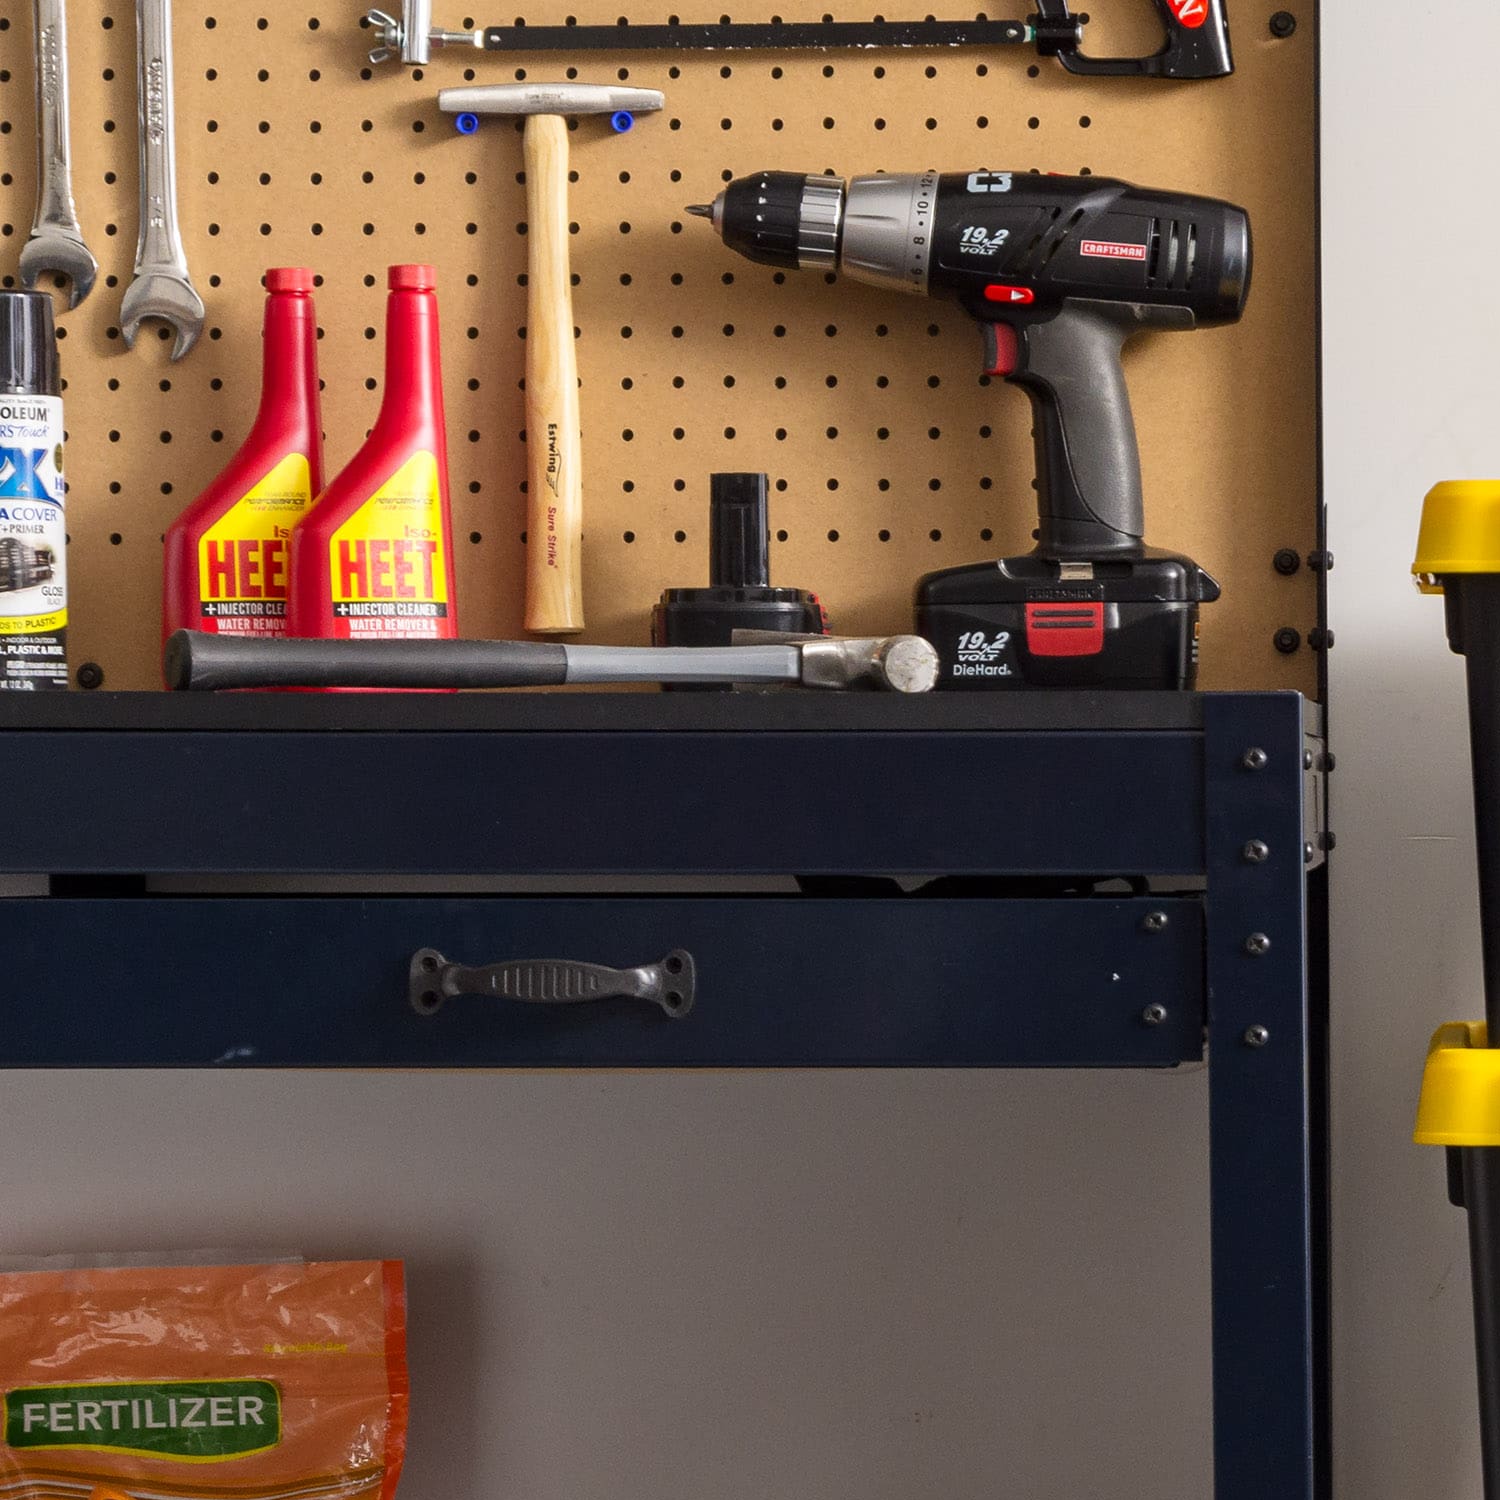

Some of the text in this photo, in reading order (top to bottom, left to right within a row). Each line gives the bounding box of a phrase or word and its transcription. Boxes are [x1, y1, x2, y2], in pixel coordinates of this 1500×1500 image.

[966, 172, 1013, 192] C3
[917, 201, 929, 215] 10
[913, 236, 925, 246] 8
[960, 226, 1009, 247] 19.2
[959, 246, 998, 256] VOLT
[1082, 243, 1145, 257] CRAFTSMAN
[911, 266, 923, 275] 6
[547, 423, 557, 473] Estwing
[12, 507, 57, 521] COVER
[547, 506, 557, 531] Sure
[273, 525, 289, 538] Is
[206, 539, 287, 598] HEE
[338, 539, 437, 599] HEET
[396, 604, 437, 616] CLEANER
[13, 621, 23, 630] TO
[217, 618, 250, 630] WATER
[349, 619, 382, 631] WATER
[384, 619, 428, 631] REMOVER
[957, 631, 1010, 650] 19.2
[958, 652, 1000, 663] VOLT
[953, 663, 1008, 676] DieHard
[23, 1396, 265, 1433] FERTILIZER
